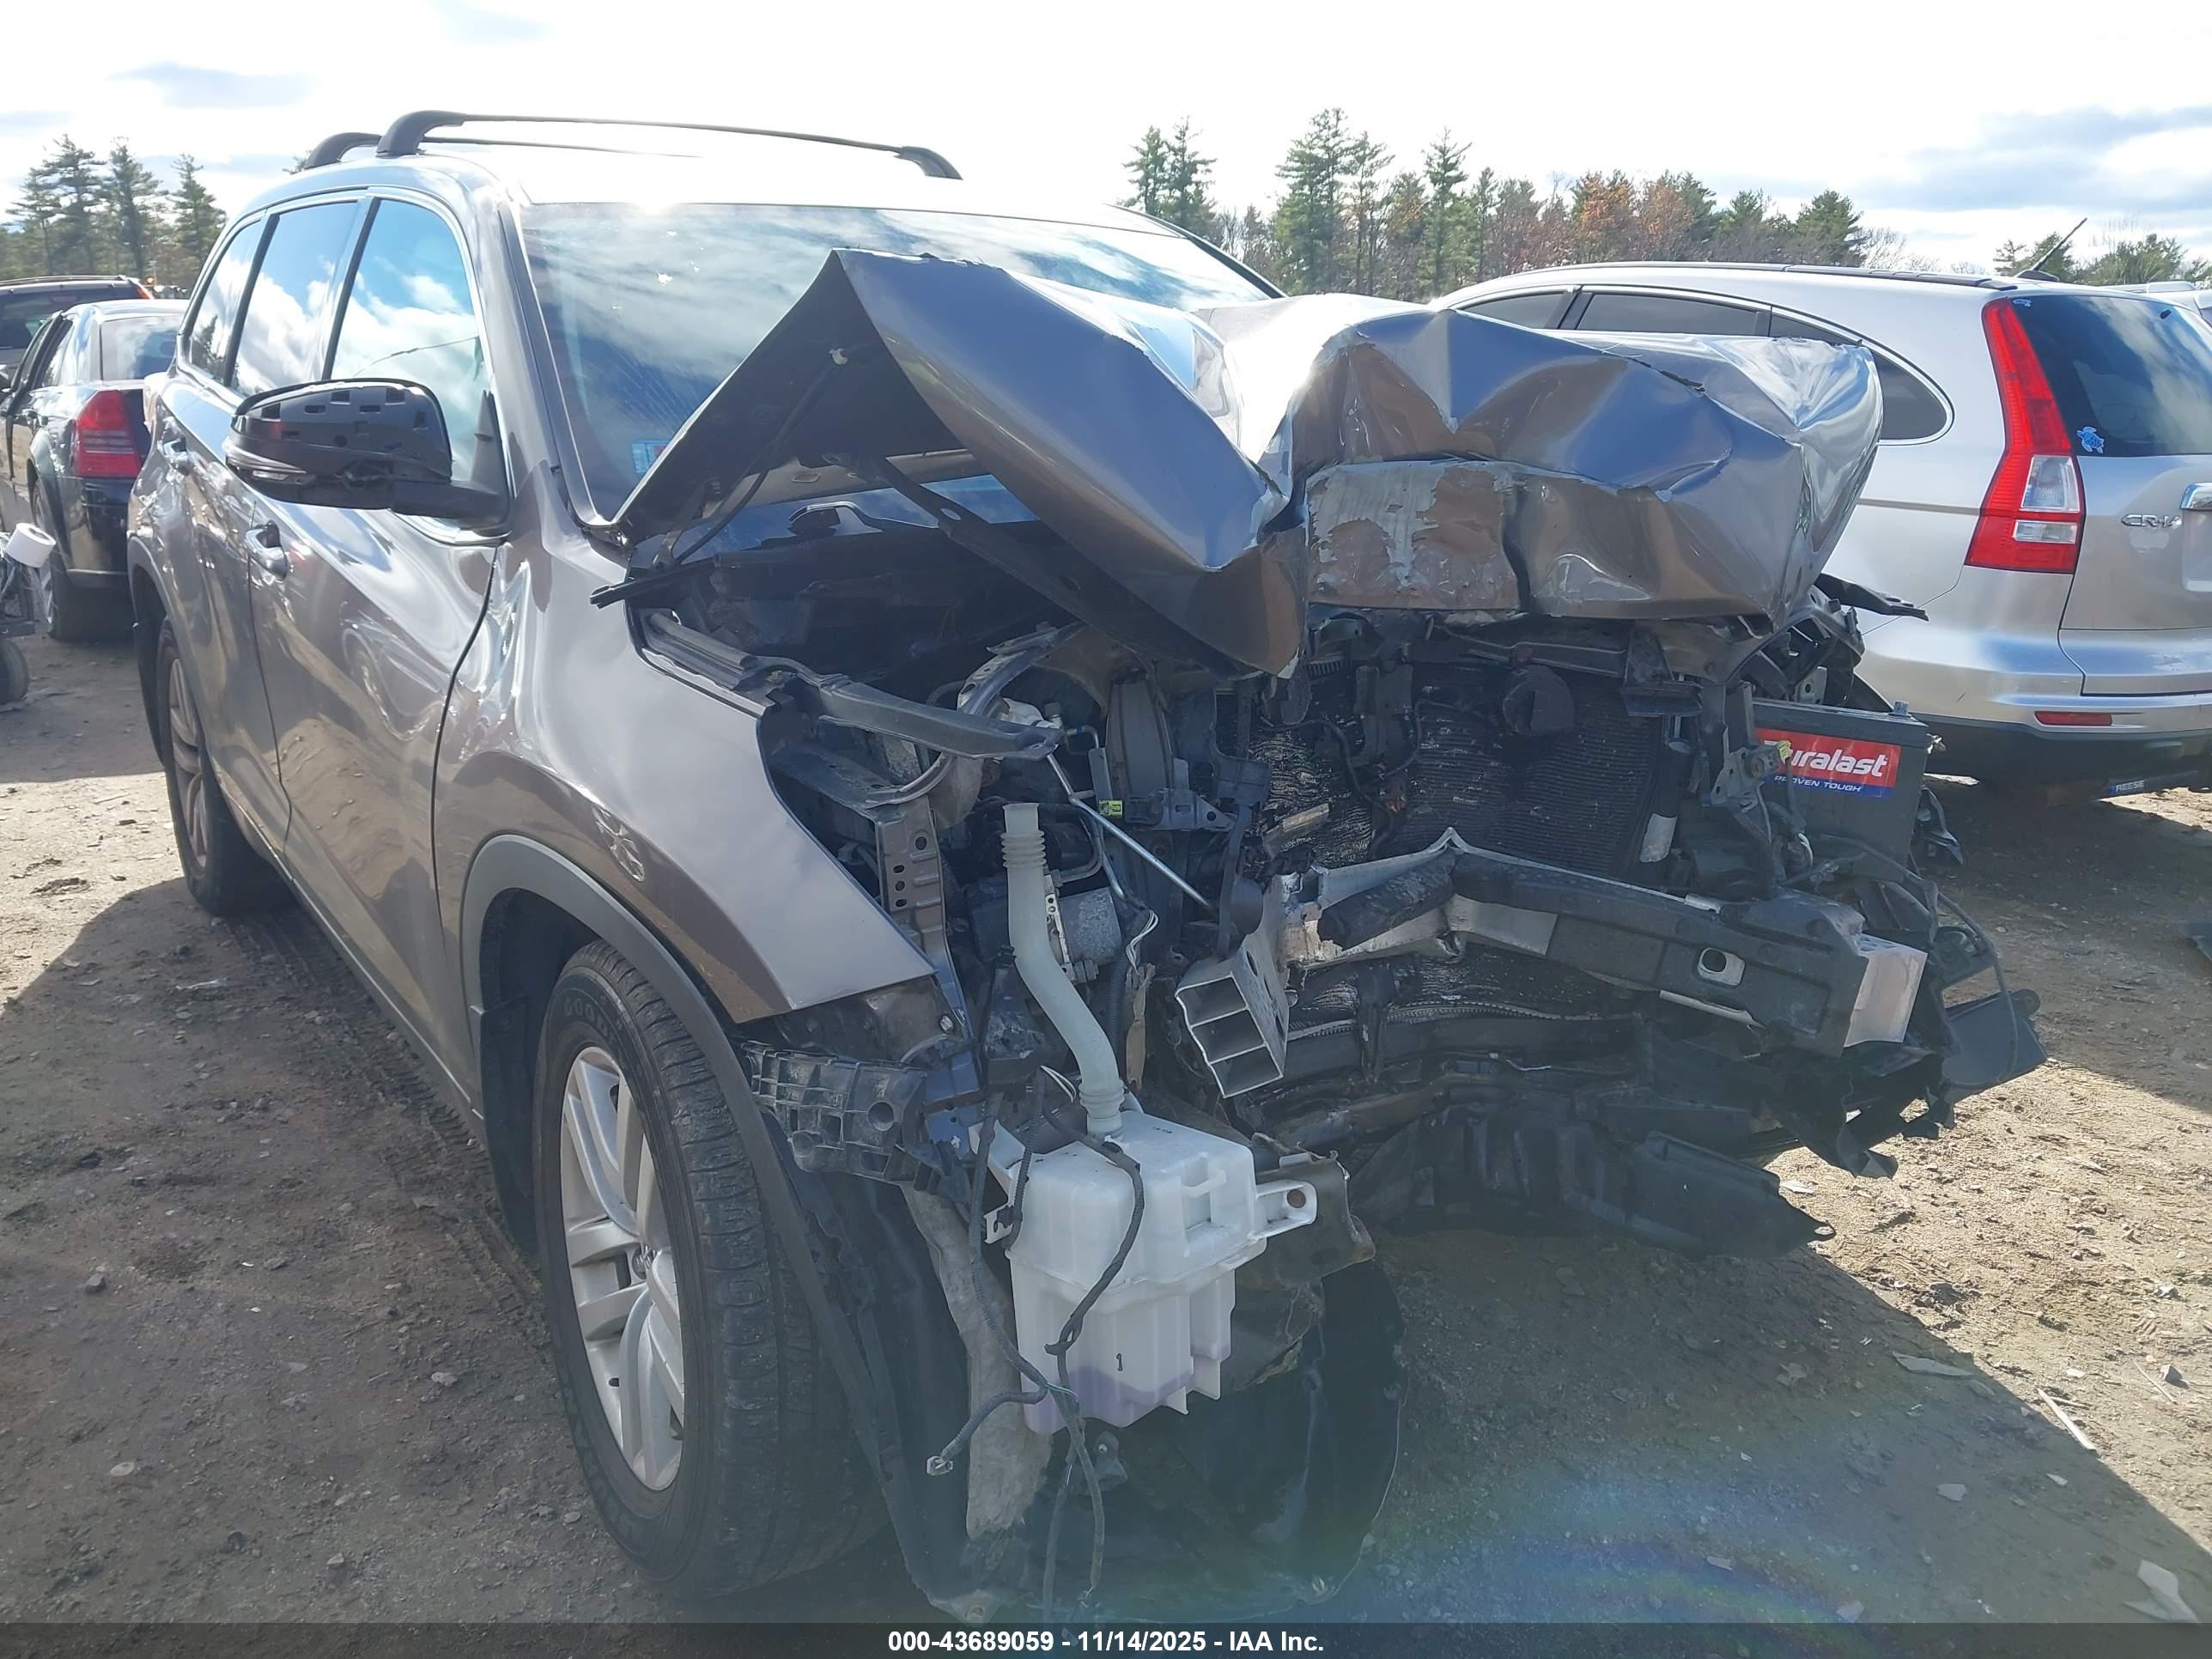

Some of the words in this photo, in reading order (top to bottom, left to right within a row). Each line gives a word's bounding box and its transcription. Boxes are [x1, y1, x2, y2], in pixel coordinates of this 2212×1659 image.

[2122, 514, 2182, 529] CR-V
[1765, 740, 1888, 777] ralast
[1823, 781, 1863, 793] TOUGH
